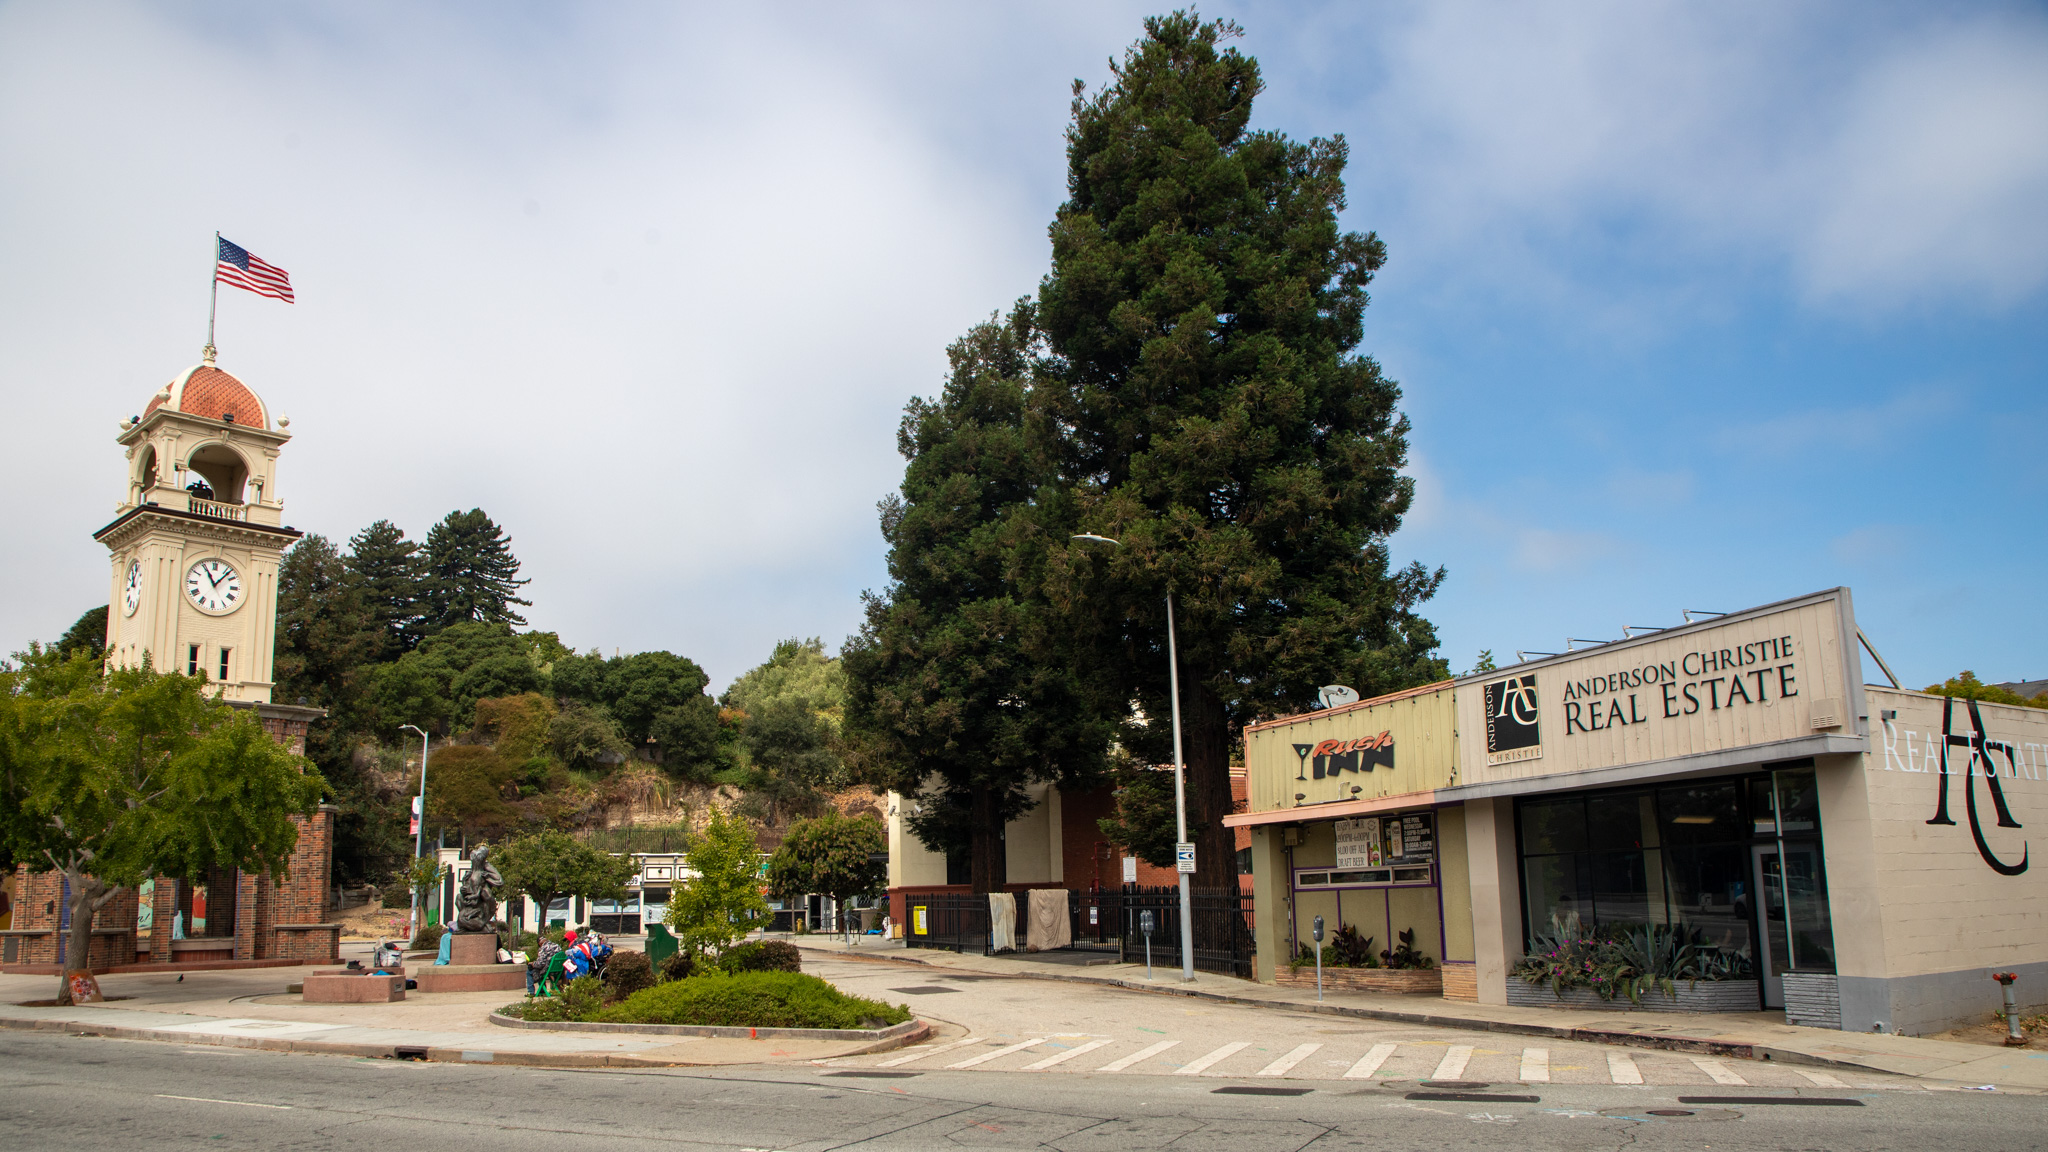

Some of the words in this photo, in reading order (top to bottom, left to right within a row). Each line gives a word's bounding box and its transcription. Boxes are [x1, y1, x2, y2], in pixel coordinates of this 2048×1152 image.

[1563, 661, 1677, 701] ANDERSON
[1682, 635, 1794, 676] CHRISTIE
[1485, 685, 1497, 752] ANDERSON
[1563, 693, 1647, 736] REAL
[1659, 663, 1798, 719] ESTATE
[1313, 730, 1395, 758] Rush
[1313, 743, 1395, 779] INN
[1488, 748, 1541, 764] CHRISTIE
[1879, 720, 1958, 775] REAL
